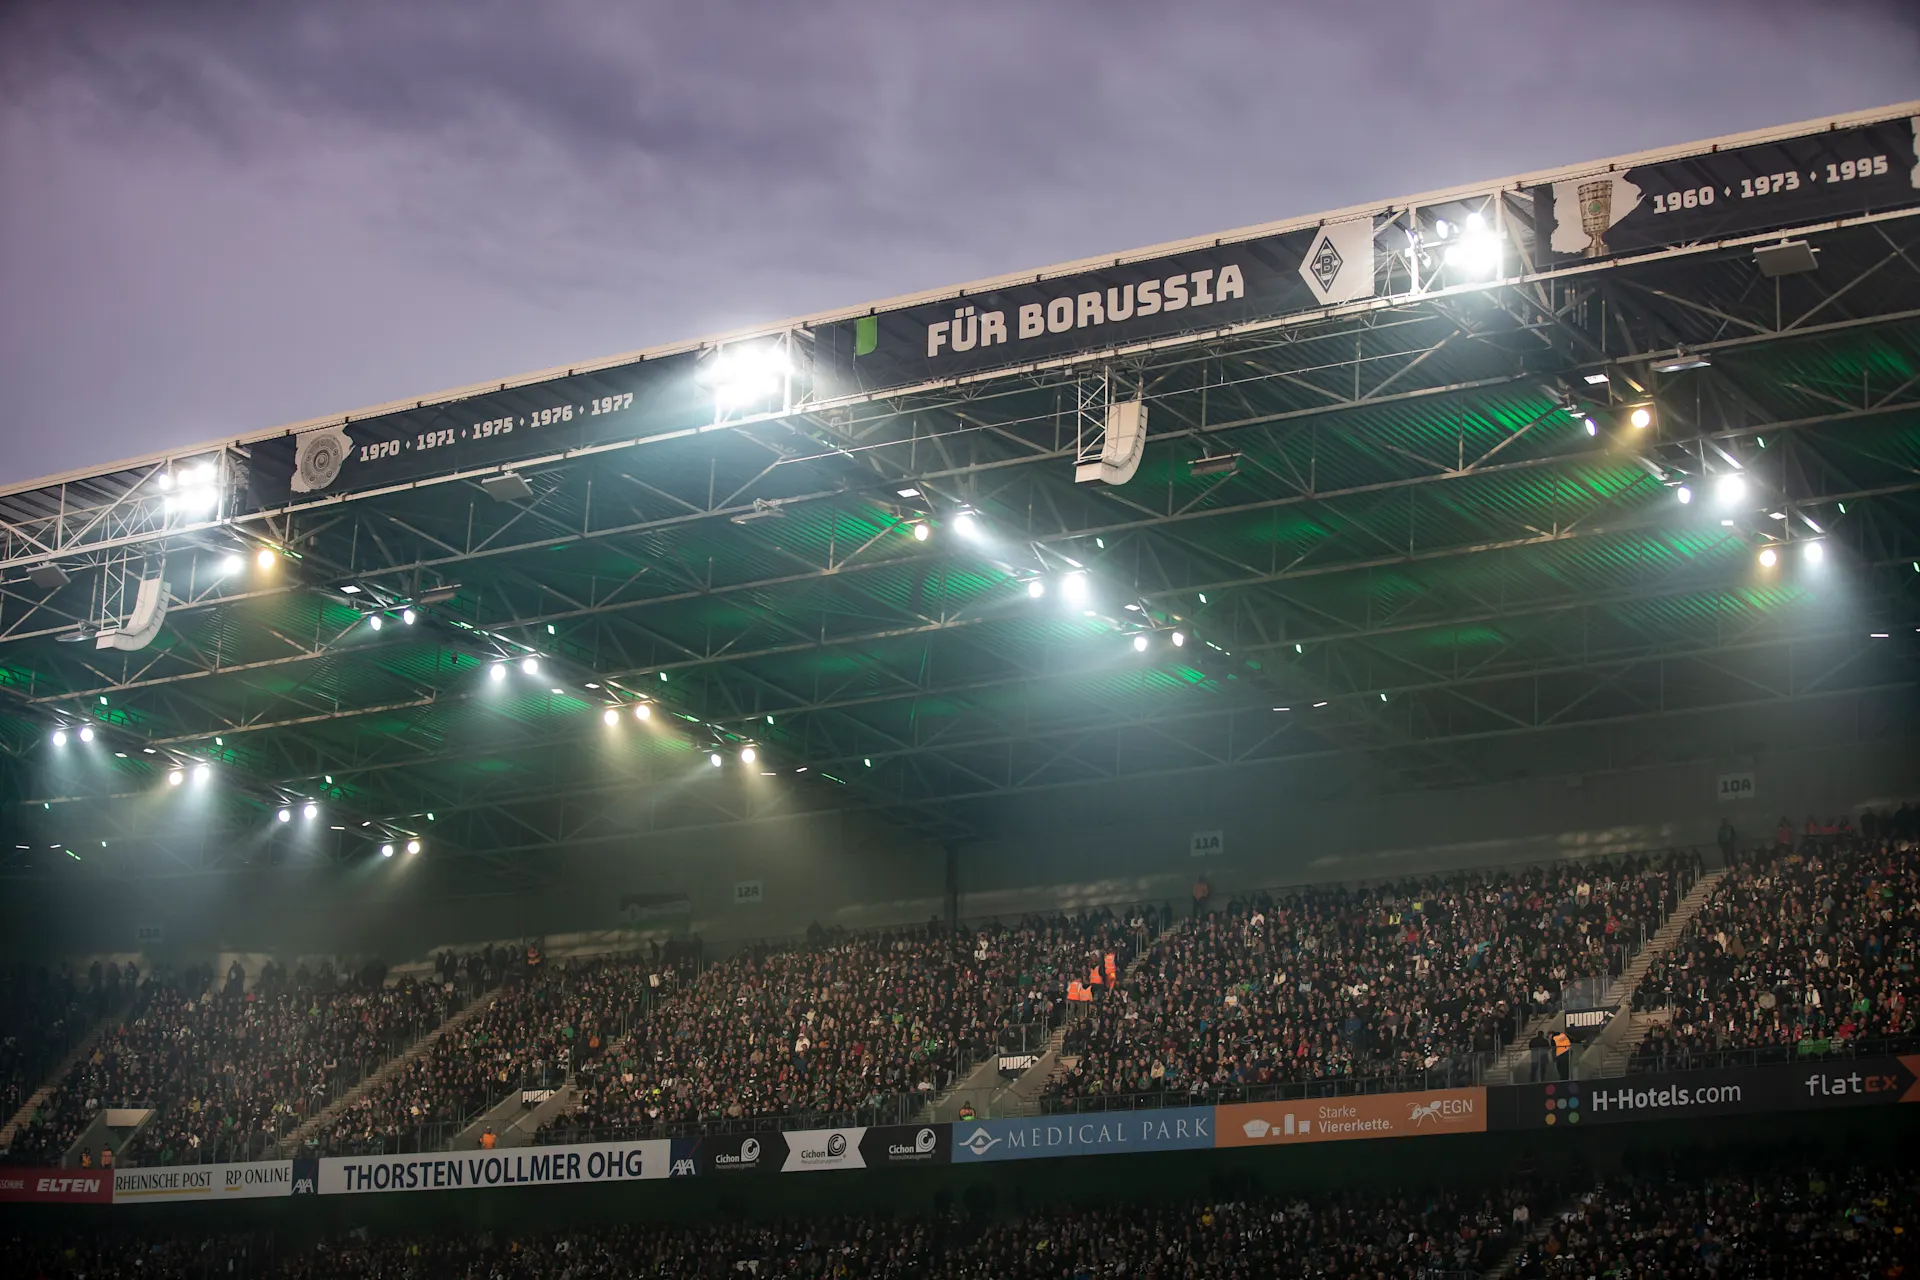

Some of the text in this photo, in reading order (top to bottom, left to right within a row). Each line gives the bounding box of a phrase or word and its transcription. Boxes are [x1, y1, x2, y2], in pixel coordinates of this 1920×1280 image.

[1653, 156, 1889, 214] 1960 1973 1995
[925, 263, 1245, 357] FÜR BORUSSIA
[359, 392, 634, 462] 1970 1971 1975 1976 1977
[1721, 779, 1752, 793] 10A
[1195, 837, 1220, 850] 11A
[737, 886, 760, 898] 12A
[1565, 1010, 1604, 1028] PUMA
[998, 1055, 1032, 1071] PUMA
[522, 1089, 550, 1104] PUMA
[1592, 1084, 1741, 1112] H-Hotels.com
[1318, 1105, 1357, 1119] Starke
[1442, 1098, 1474, 1115] EGN
[1007, 1117, 1209, 1149] MEDICAL PARK
[1318, 1117, 1394, 1134] Viererkette.
[801, 1149, 826, 1160] Cichon
[888, 1142, 914, 1154] Cichon
[715, 1153, 740, 1164] Cichon
[224, 1166, 291, 1185] RP ONLINE
[344, 1149, 643, 1191] THORSTEN VOLLMER OHG
[669, 1158, 696, 1177] AXA
[36, 1178, 101, 1193] ELTEN
[114, 1170, 213, 1191] RHEINISCHE POST
[292, 1178, 314, 1194] AXA
